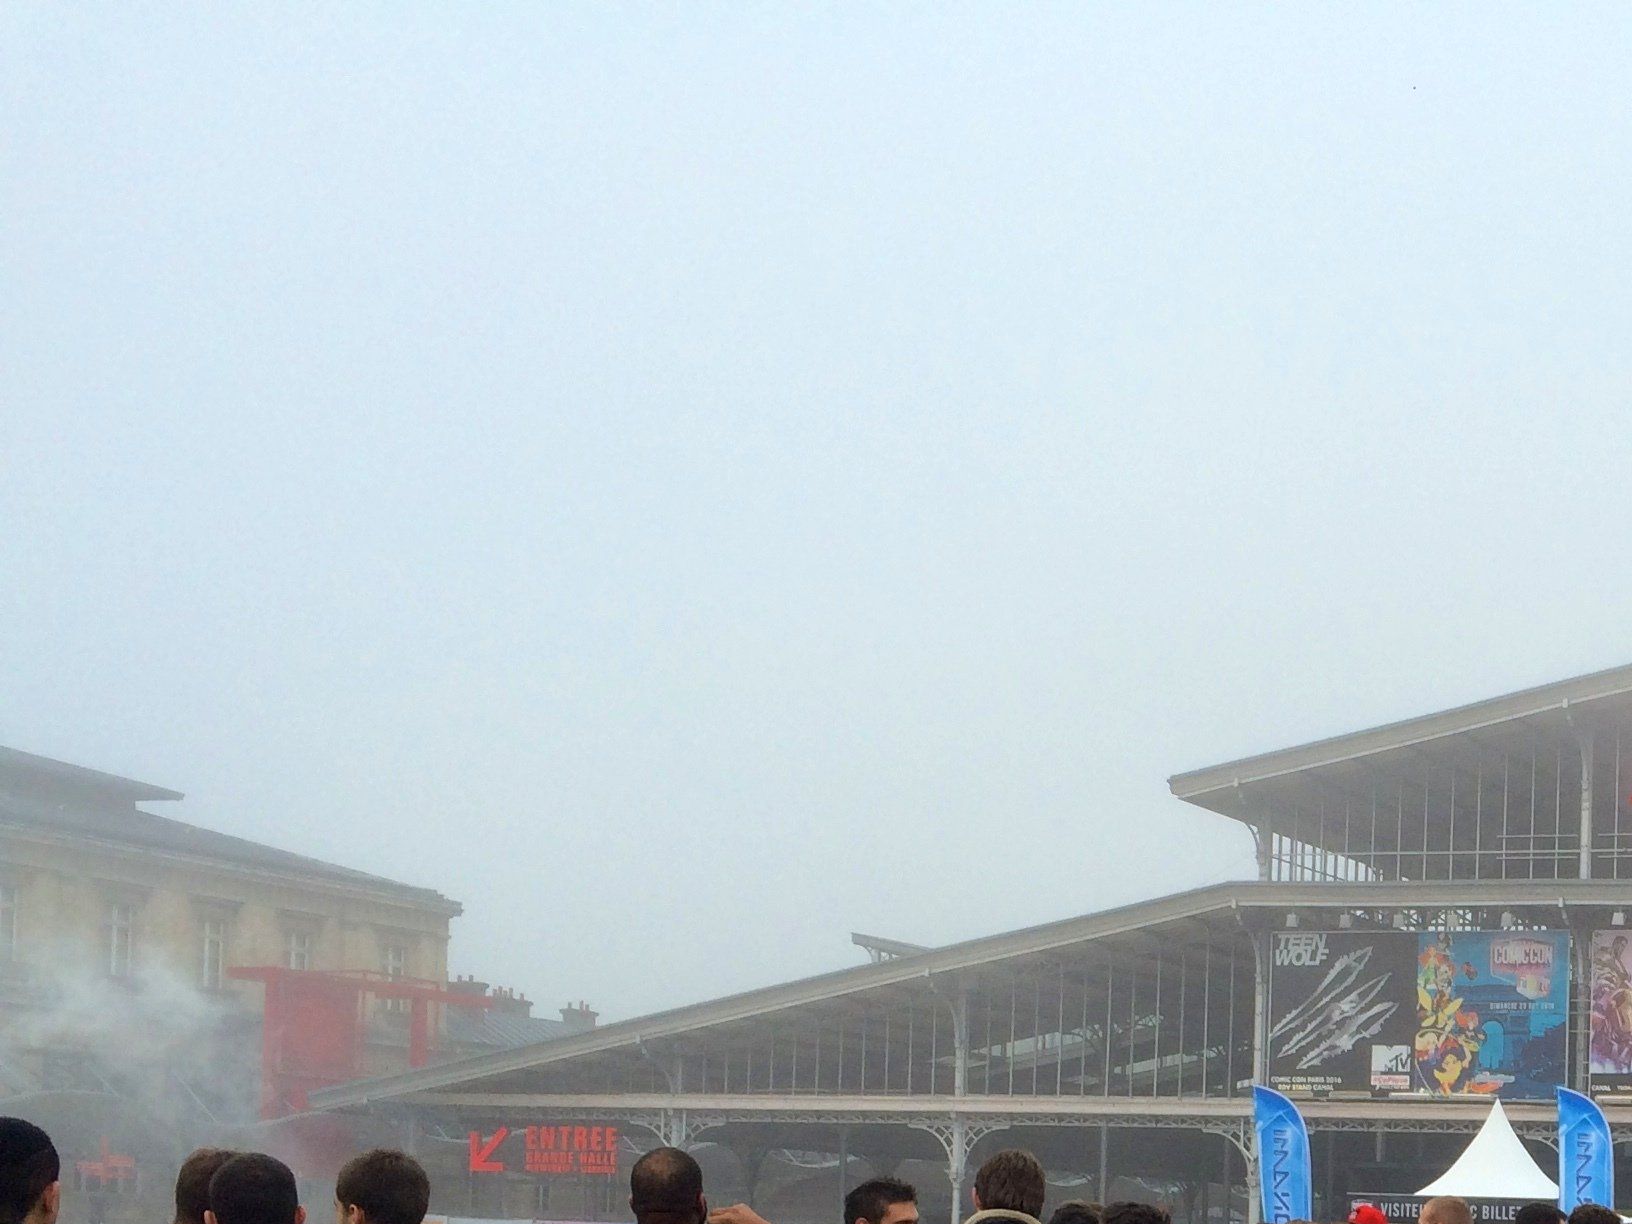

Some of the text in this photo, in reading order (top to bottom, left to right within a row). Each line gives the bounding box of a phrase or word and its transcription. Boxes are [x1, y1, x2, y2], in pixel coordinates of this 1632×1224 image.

[1278, 934, 1328, 950] TEEN
[1276, 949, 1329, 966] WOLF
[1371, 1045, 1411, 1072] MTV
[1381, 1202, 1422, 1218] VISITE
